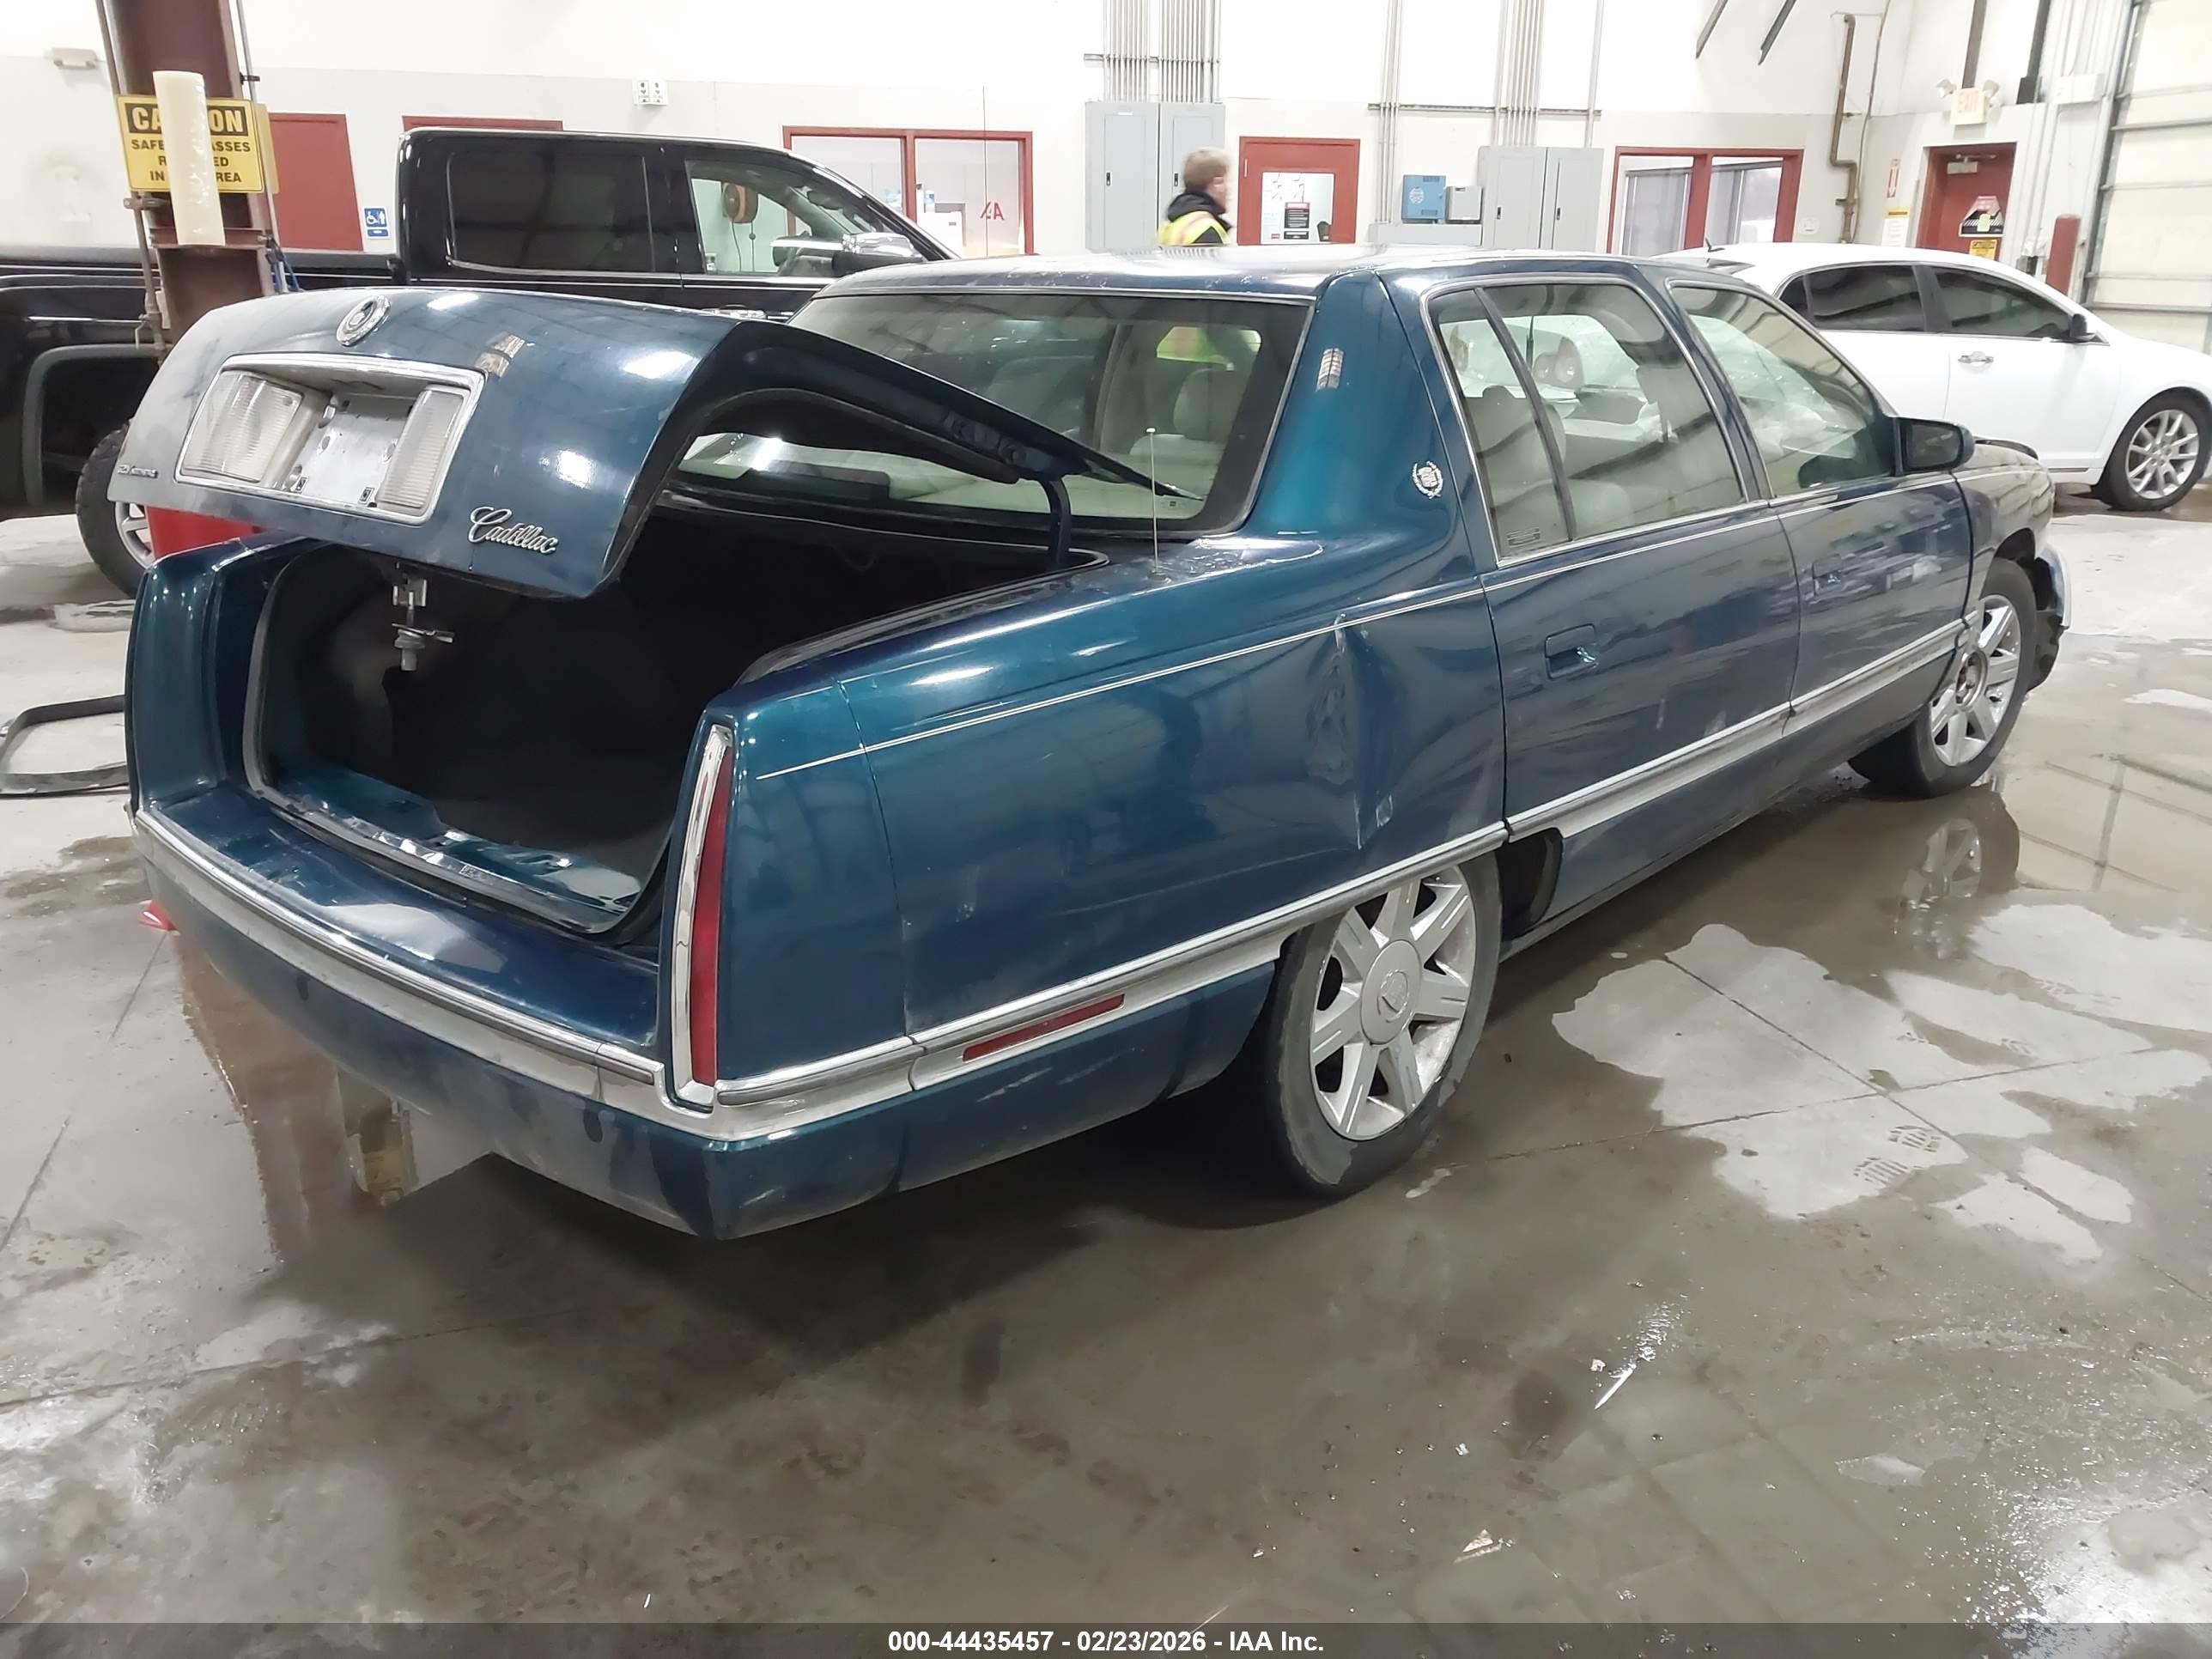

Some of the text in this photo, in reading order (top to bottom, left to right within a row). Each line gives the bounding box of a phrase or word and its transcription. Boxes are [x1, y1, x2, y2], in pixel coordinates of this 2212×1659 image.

[150, 171, 241, 182] IN REA
[468, 506, 559, 554] Cadillac
